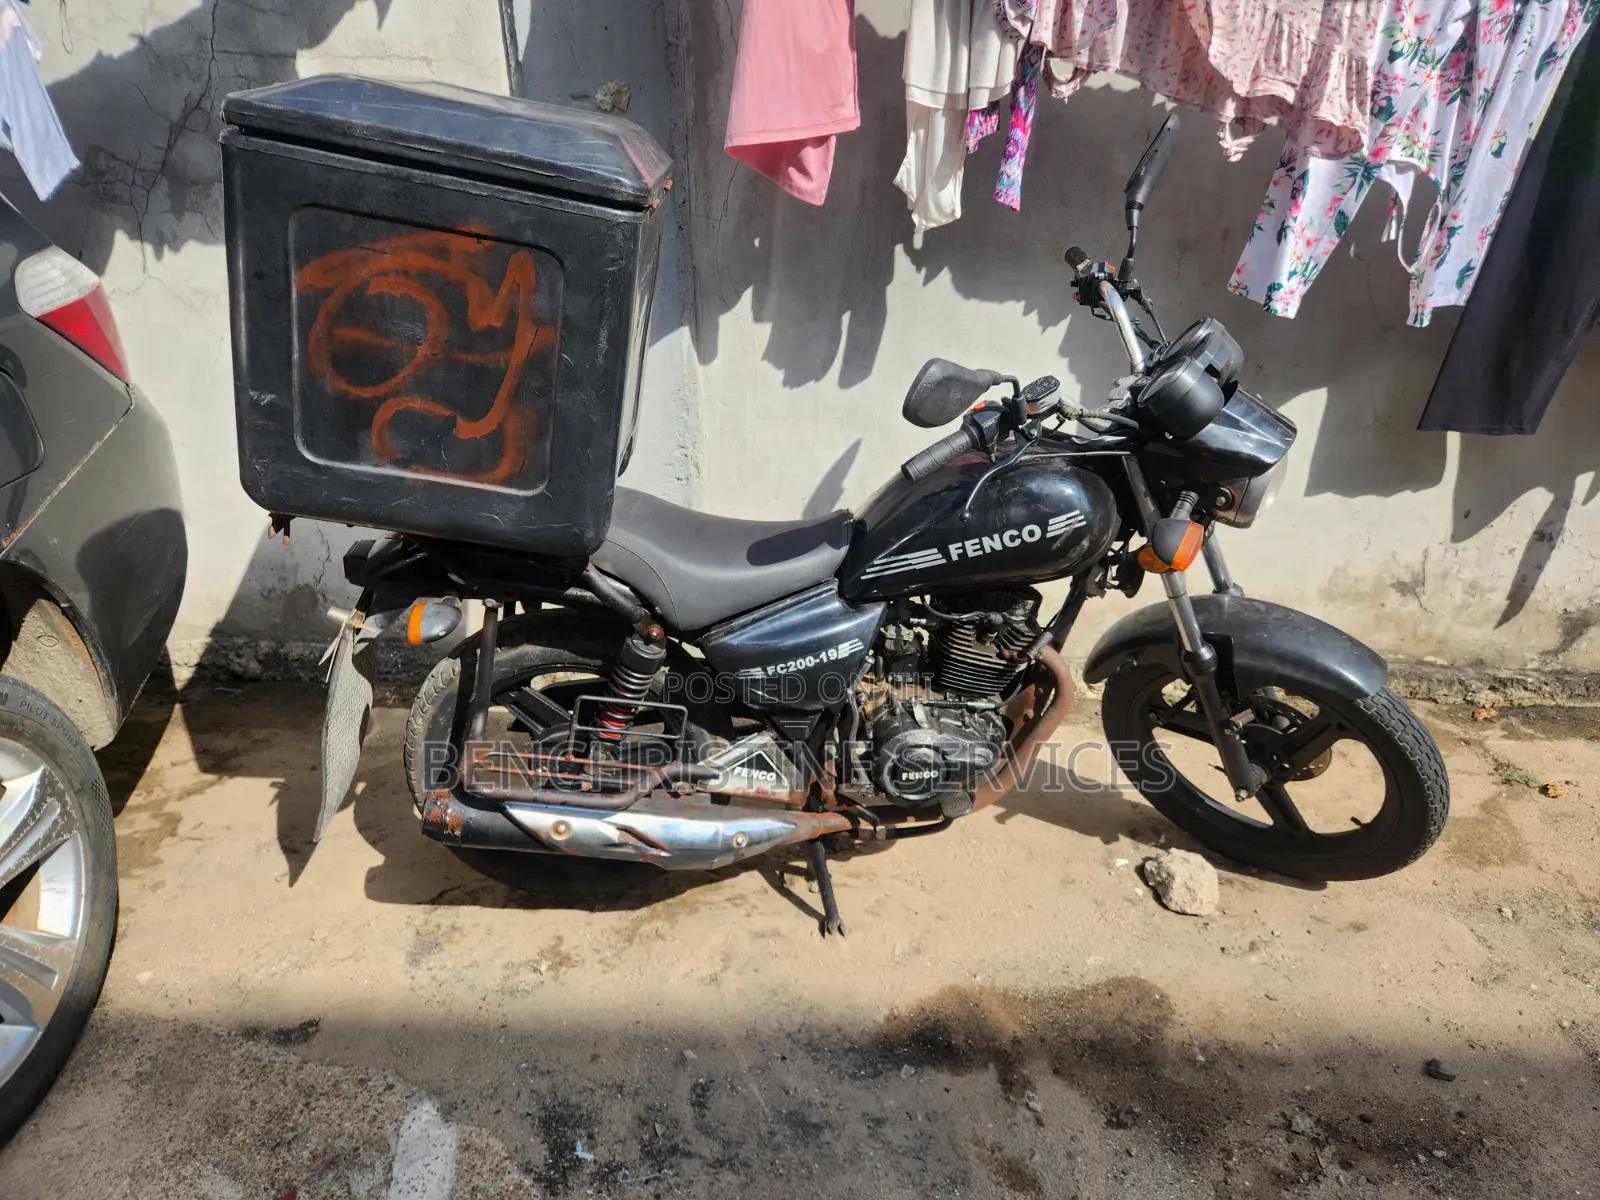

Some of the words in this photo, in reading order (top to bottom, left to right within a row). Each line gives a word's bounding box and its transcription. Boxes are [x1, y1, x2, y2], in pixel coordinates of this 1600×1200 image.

[948, 524, 1041, 561] FENCO
[766, 649, 837, 677] FC200-19
[20, 700, 49, 720] PILOT
[733, 766, 776, 781] FENCO
[902, 769, 939, 781] FENCO
